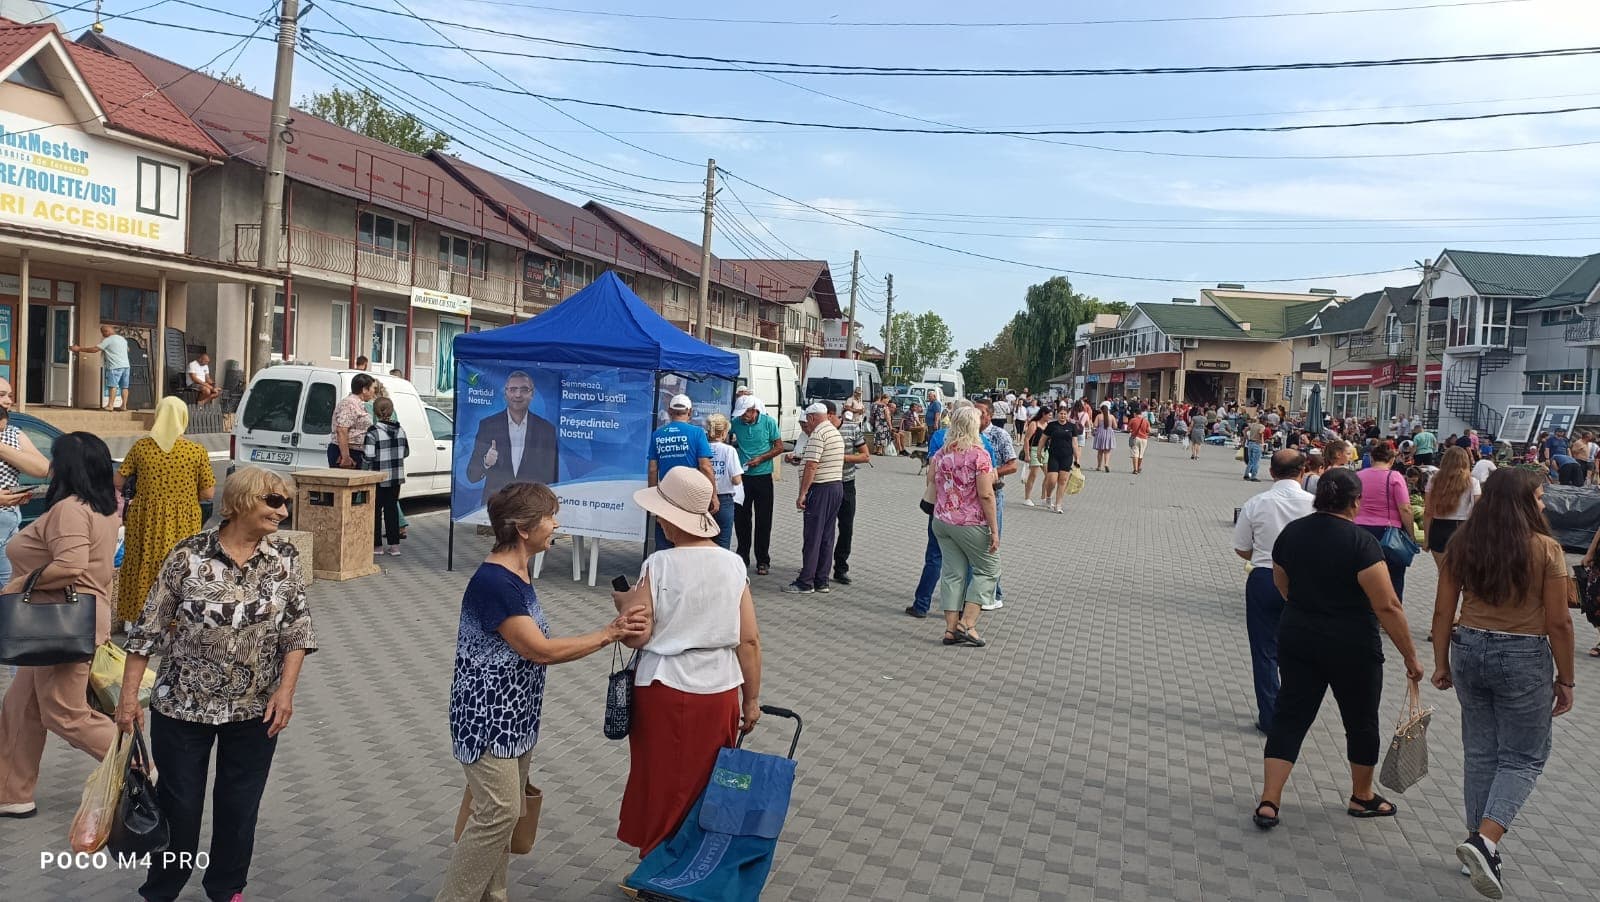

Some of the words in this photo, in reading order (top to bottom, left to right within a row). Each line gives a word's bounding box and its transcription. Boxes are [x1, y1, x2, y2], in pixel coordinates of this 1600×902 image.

[32, 200, 160, 240] ACCESIBILE
[561, 380, 603, 391] Semnează,
[468, 387, 494, 397] Partidul
[562, 390, 596, 401] Renato
[560, 428, 594, 440] Nostru!
[277, 453, 290, 462] 522
[556, 496, 581, 506] Сила
[589, 501, 624, 511] правде!
